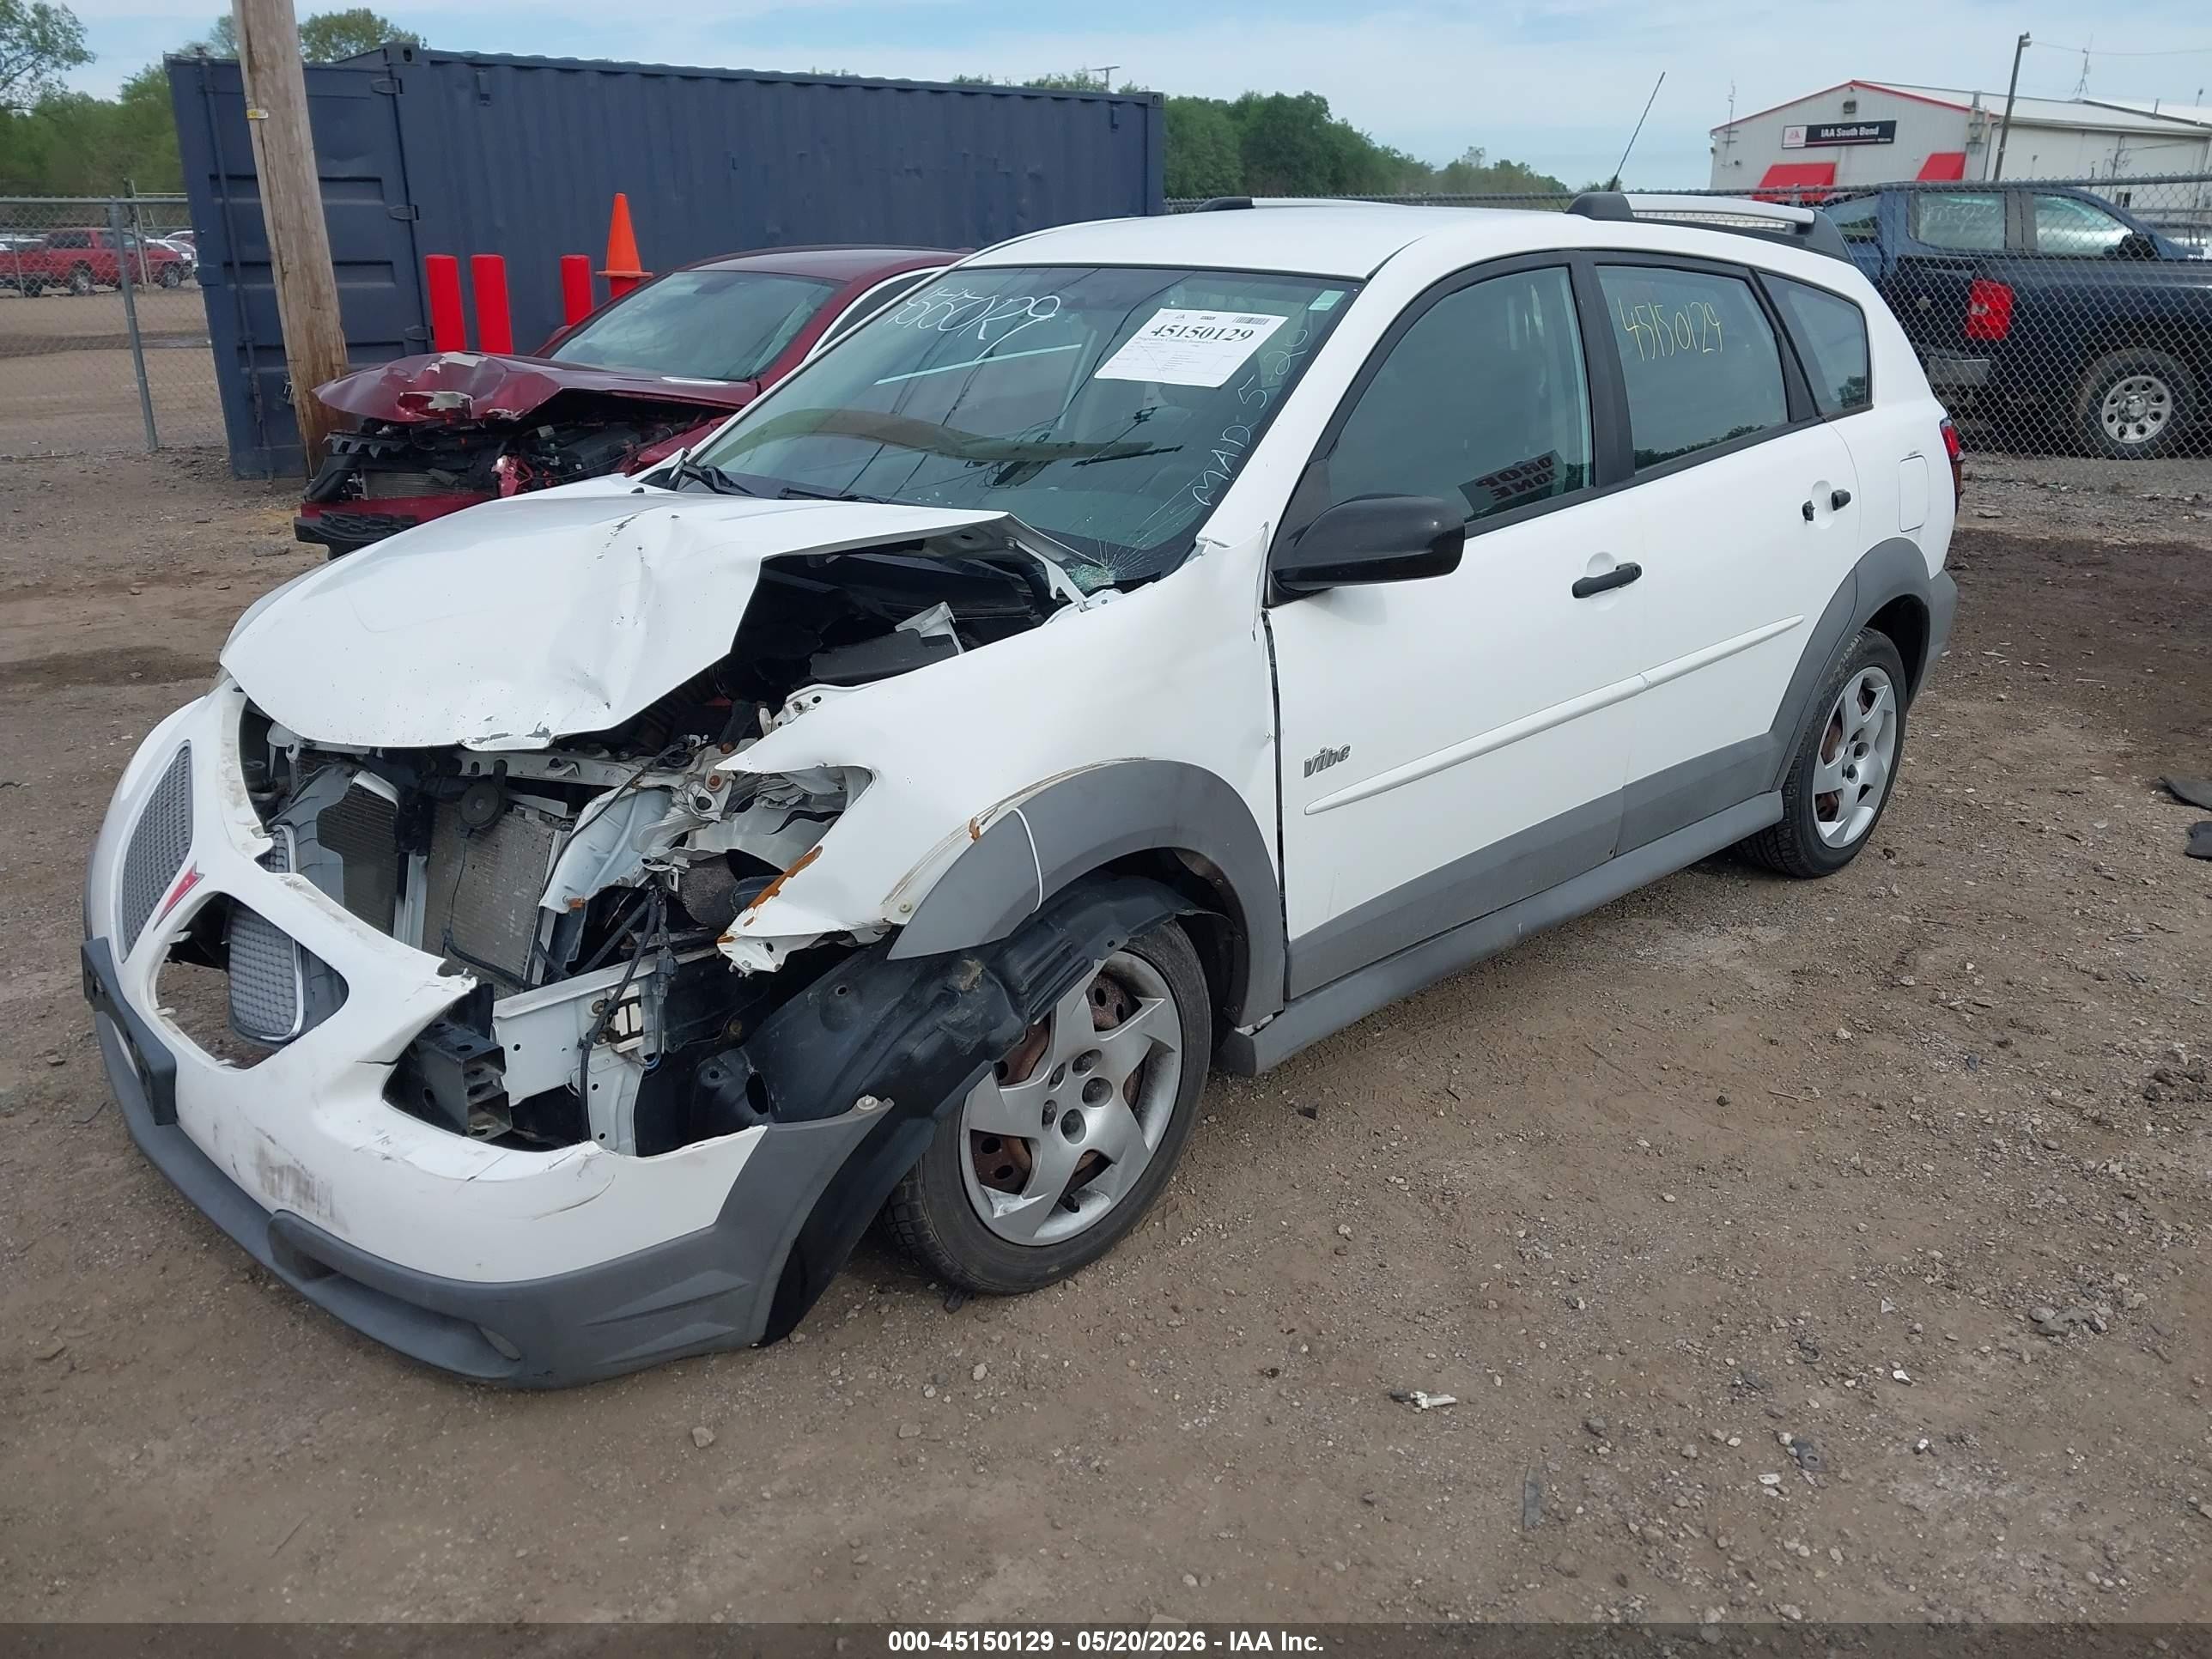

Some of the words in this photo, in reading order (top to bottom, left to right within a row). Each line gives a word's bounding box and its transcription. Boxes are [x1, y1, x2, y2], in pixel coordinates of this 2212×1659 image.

[1820, 128, 1835, 137] IAA
[1836, 127, 1858, 137] South
[1859, 125, 1879, 136] Bend
[1151, 324, 1255, 342] 45150129
[1618, 296, 1723, 362] 45150129
[1192, 424, 1251, 506] MAD
